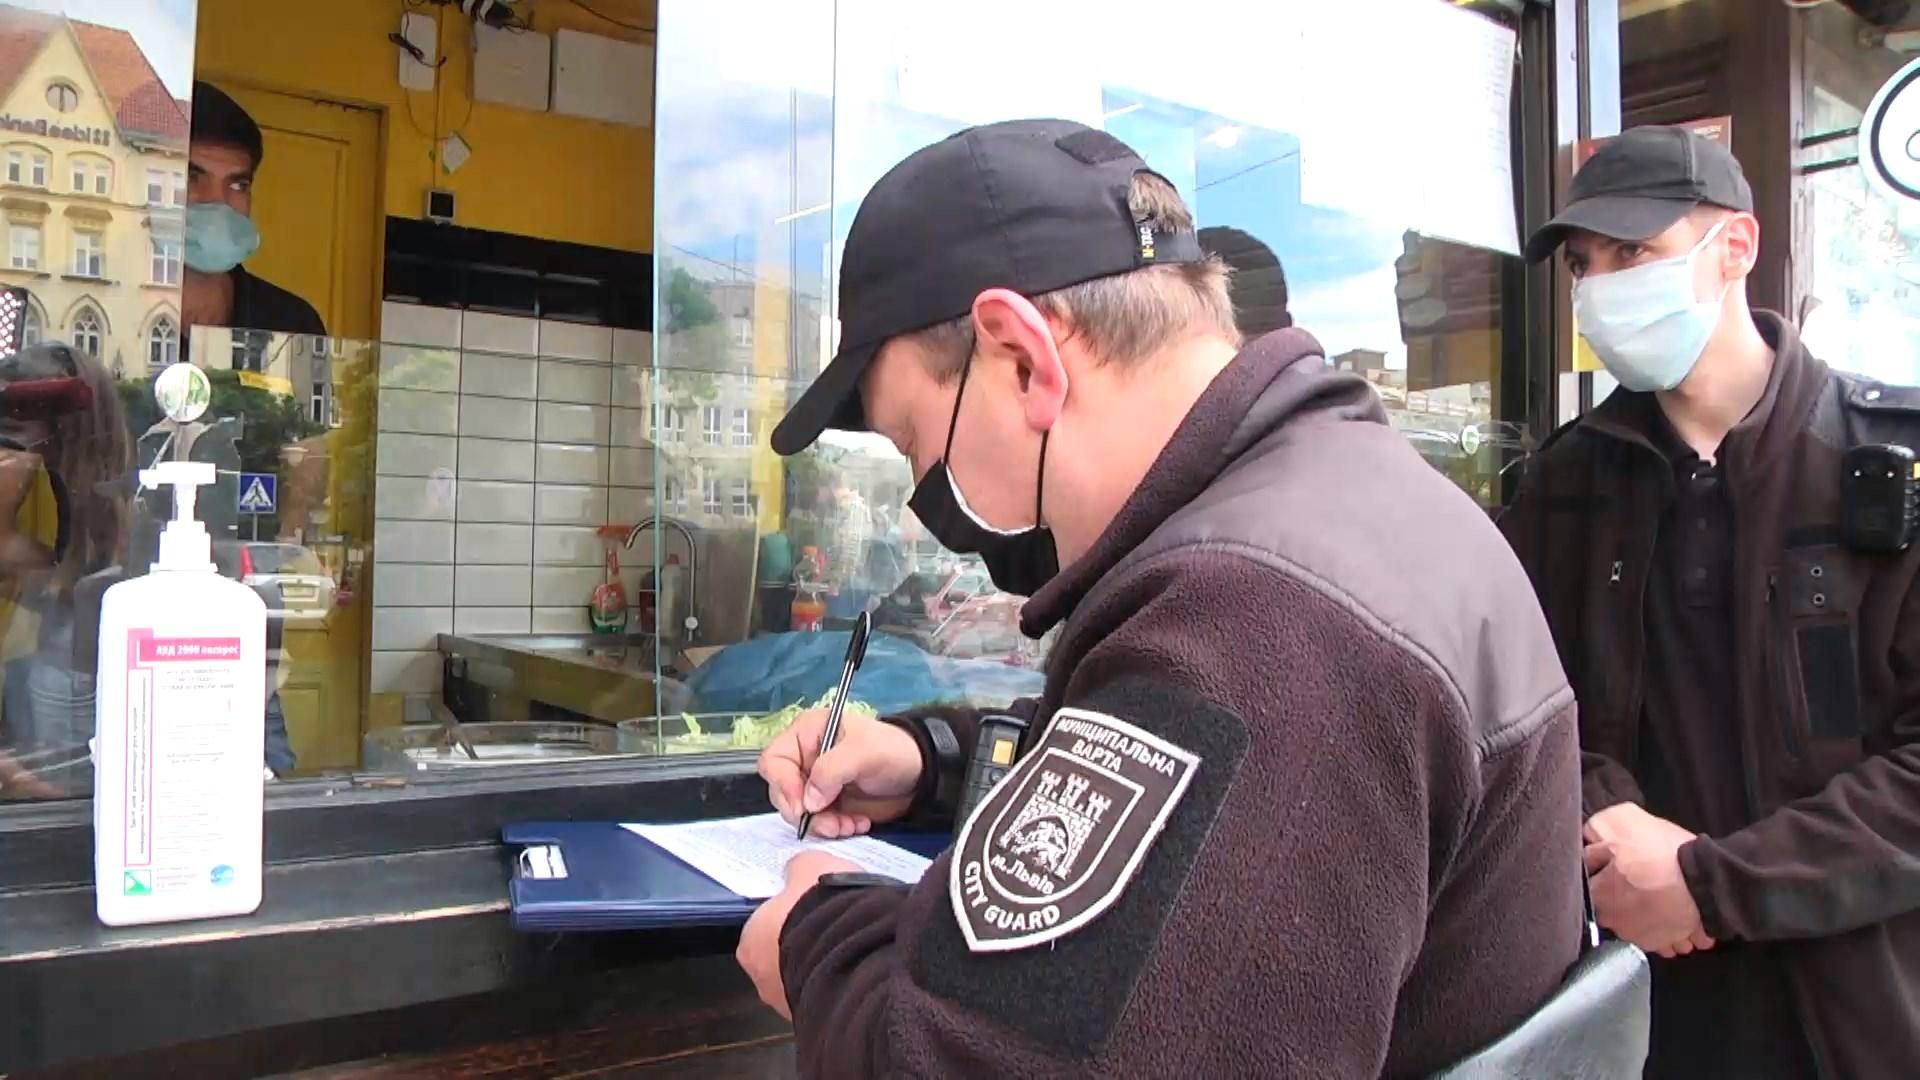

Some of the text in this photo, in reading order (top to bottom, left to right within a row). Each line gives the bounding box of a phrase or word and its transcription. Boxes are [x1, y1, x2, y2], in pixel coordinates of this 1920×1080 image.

[1055, 717, 1176, 777] МУНІЦИПАЛЬНА
[1071, 739, 1122, 772] ВАРТА
[965, 861, 1061, 930] CITY GUARD
